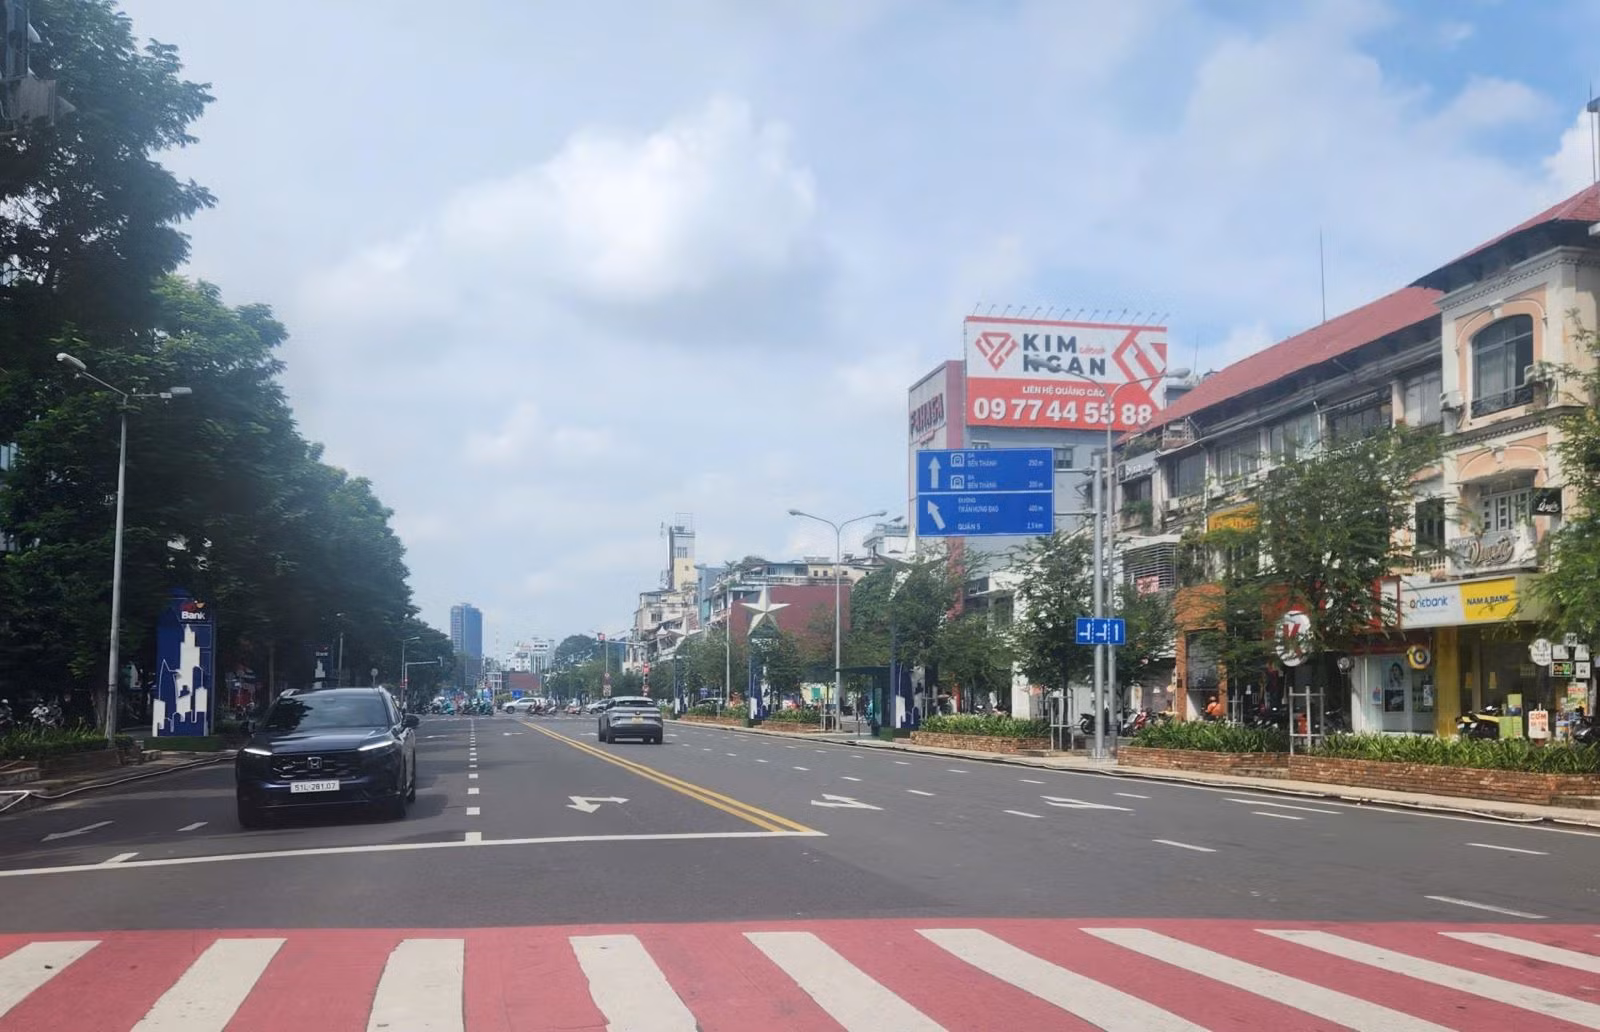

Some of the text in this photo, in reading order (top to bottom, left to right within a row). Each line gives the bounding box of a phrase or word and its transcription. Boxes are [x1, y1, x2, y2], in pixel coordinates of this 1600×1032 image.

[1023, 333, 1077, 354] KIM
[1023, 354, 1106, 376] NGAN
[1022, 385, 1041, 394] LIÊN
[1042, 385, 1055, 394] HỆ
[1055, 386, 1086, 396] QUẢNG
[973, 397, 1153, 425] 09 77 44 55 88
[1466, 597, 1484, 606] NAM
[1490, 595, 1510, 604] BANK
[181, 611, 206, 620] Bank
